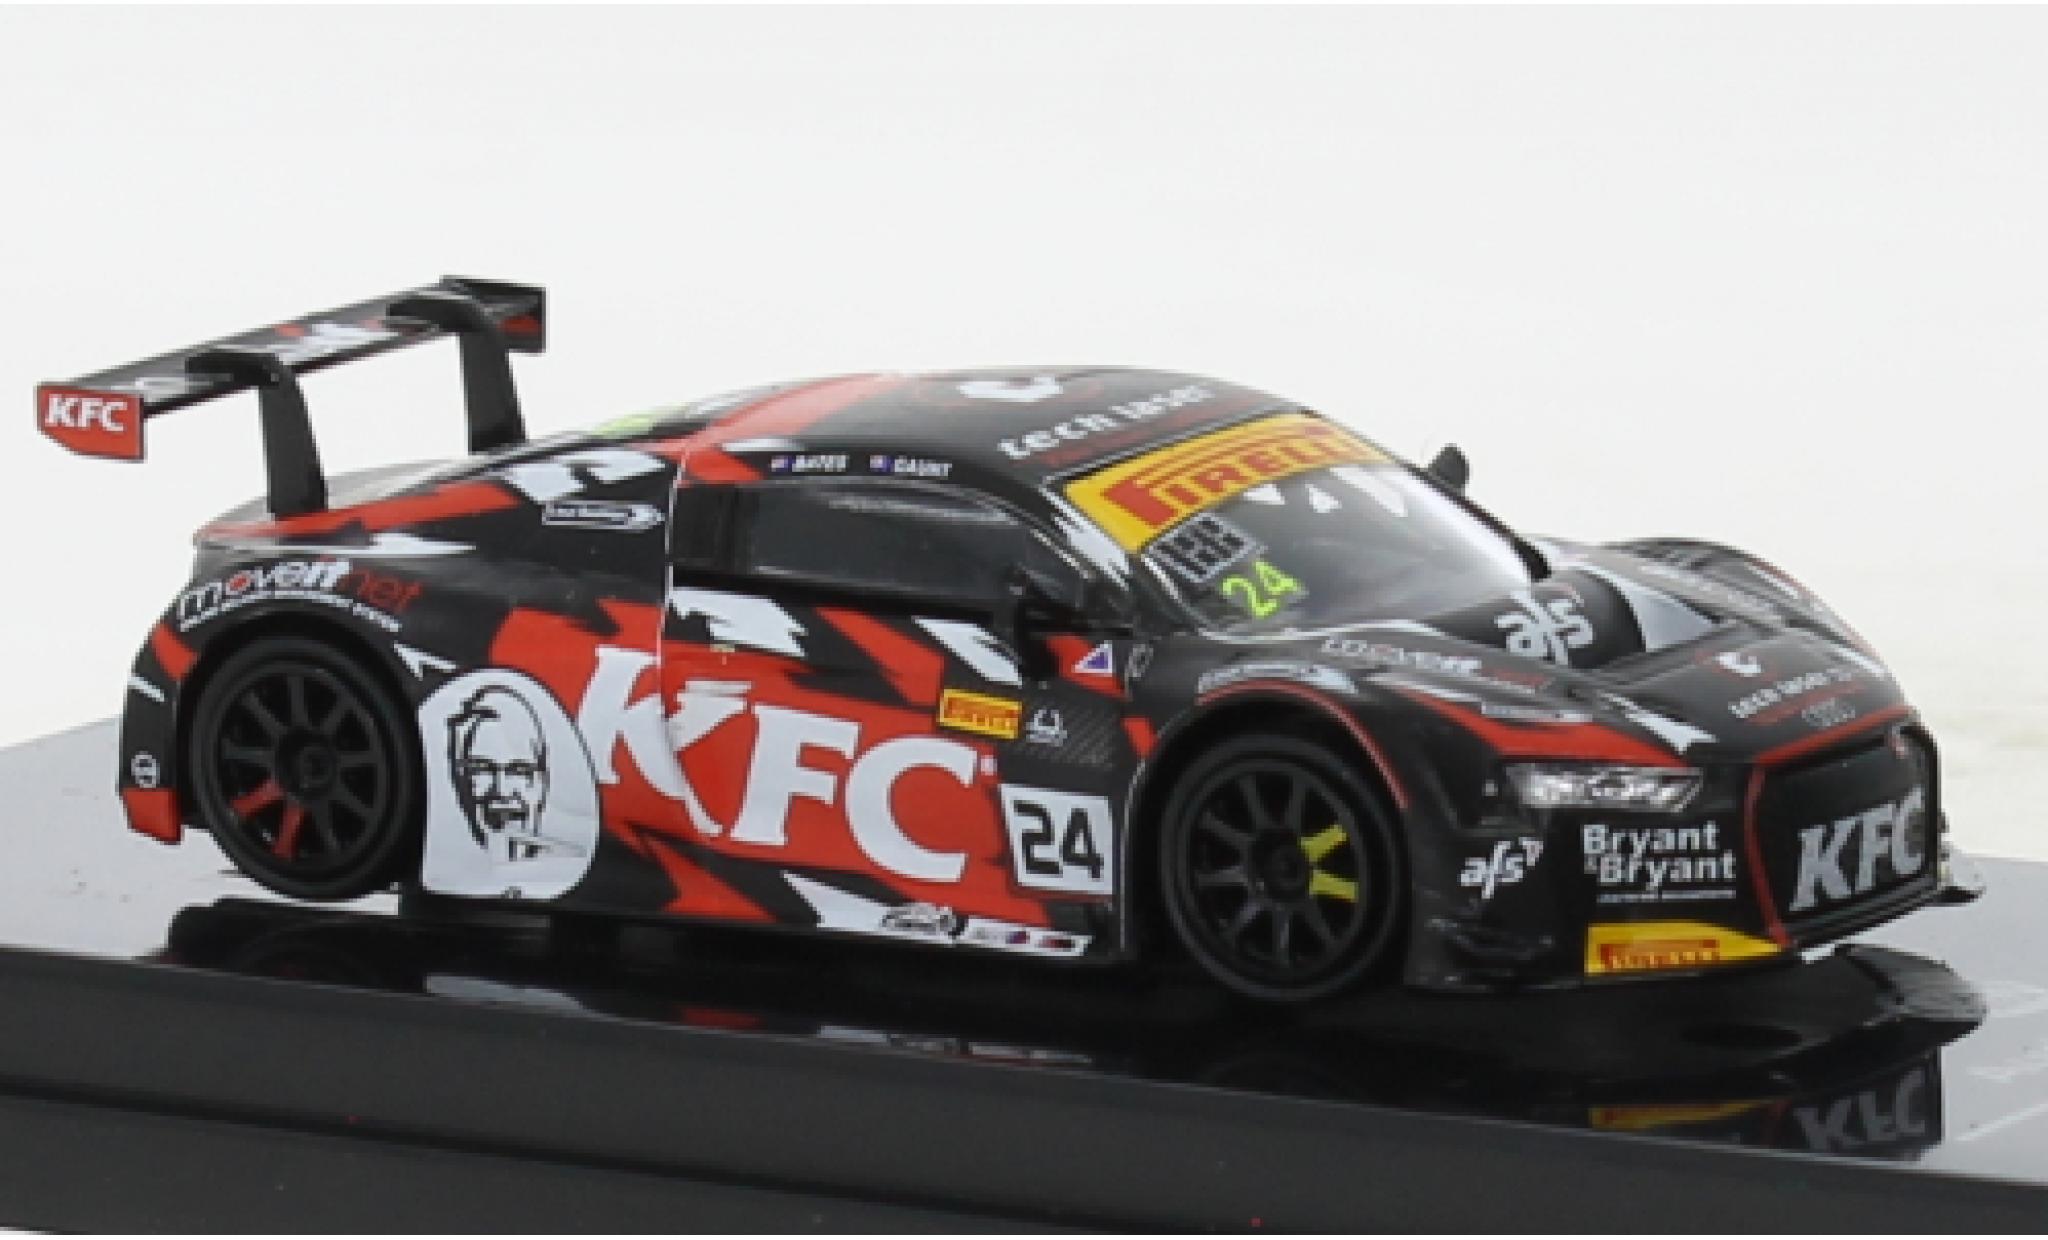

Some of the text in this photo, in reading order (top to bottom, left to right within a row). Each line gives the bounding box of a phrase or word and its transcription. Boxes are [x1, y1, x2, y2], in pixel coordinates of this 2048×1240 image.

[45, 394, 128, 432] KFC
[1102, 423, 1372, 529] PIRELLI
[1221, 559, 1300, 618] 24
[574, 643, 980, 883] KFC
[1012, 803, 1104, 880] 24
[1582, 820, 1719, 862] Bryant
[1789, 788, 1924, 912] KFC
